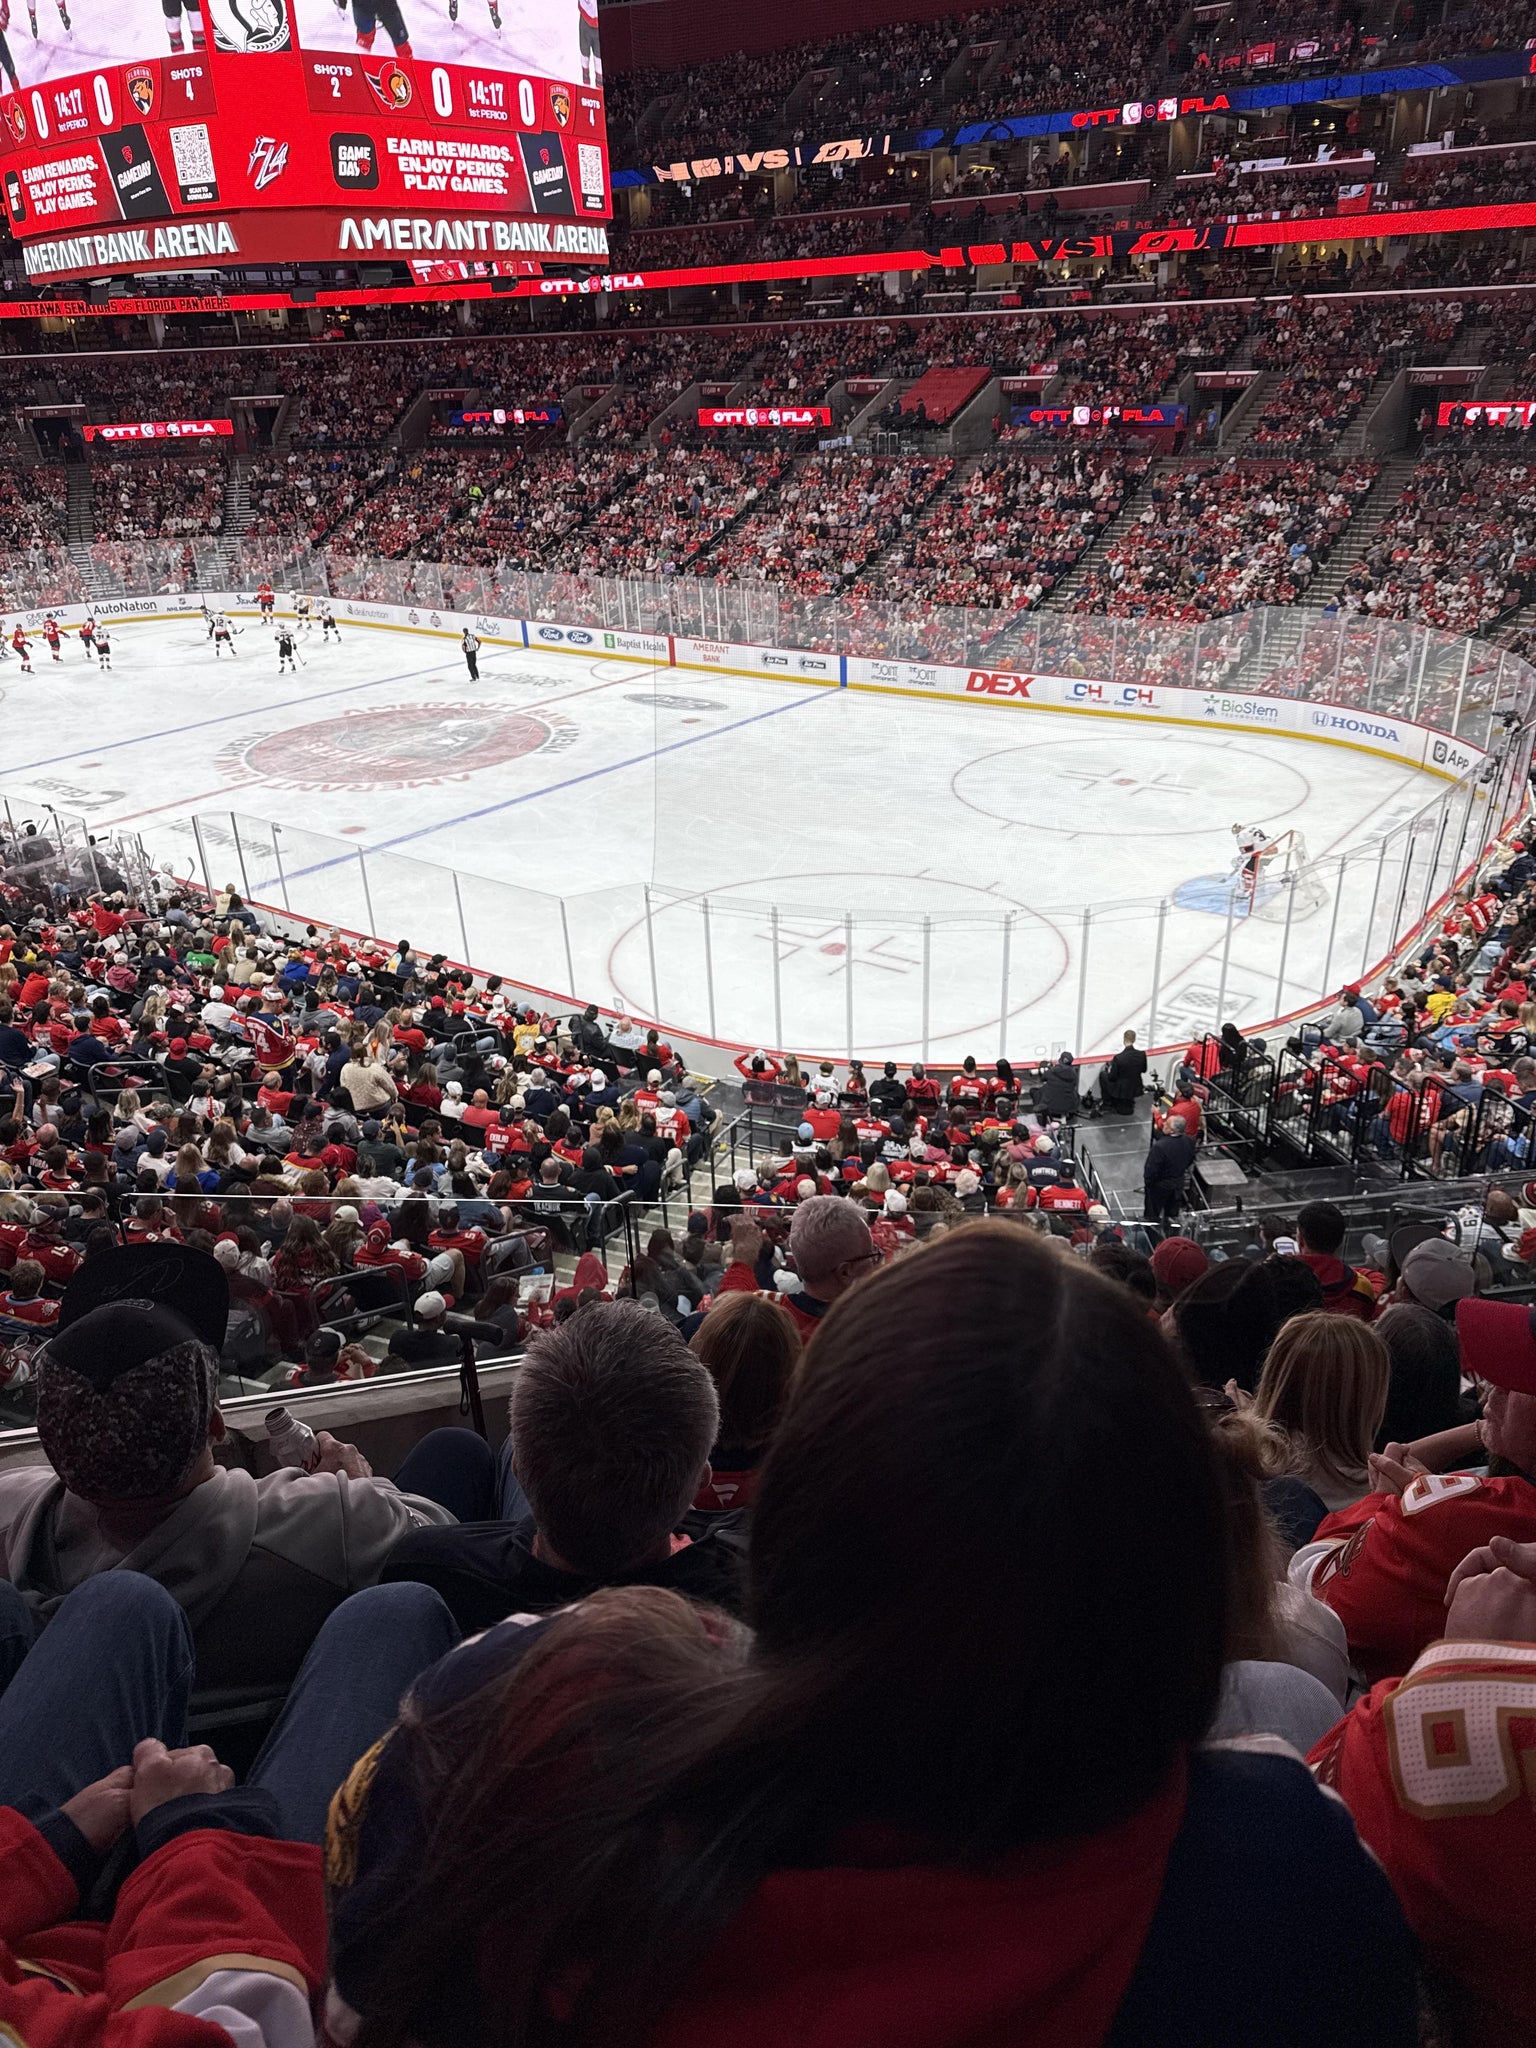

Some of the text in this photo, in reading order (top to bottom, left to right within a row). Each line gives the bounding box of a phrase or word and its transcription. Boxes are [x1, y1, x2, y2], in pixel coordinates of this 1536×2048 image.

[170, 67, 203, 80] SHOTS
[313, 63, 353, 77] SHOTS
[185, 80, 194, 101] 4
[330, 77, 341, 98] 2
[431, 67, 453, 117] 0
[469, 79, 505, 108] 14:17
[54, 88, 83, 118] 14:17
[93, 75, 113, 126] 0
[518, 79, 535, 126] 0
[31, 91, 49, 139] 0
[480, 109, 508, 121] PERIOD
[1071, 108, 1121, 128] OTT
[1181, 94, 1231, 114] FLA
[66, 118, 88, 131] PERIOD
[338, 145, 372, 161] GAME
[386, 137, 514, 162] EARN REWARDS.
[338, 161, 361, 177] DAY
[397, 156, 509, 178] ENJOY PERKS.
[737, 149, 789, 173] VS
[22, 155, 99, 184] EARN REWARDS.
[29, 180, 58, 200] ENJOY
[58, 173, 96, 193] PERKS.
[404, 174, 508, 195] PLAY GAMES.
[34, 197, 57, 216] PLAY
[57, 191, 97, 211] GAMES.
[339, 218, 609, 255] AMERANT BANK ARENA
[23, 222, 238, 275] AMERANT BANK ARENA
[614, 275, 644, 288] FLA
[19, 304, 61, 315] OTTAWA
[135, 300, 176, 313] FLORIDA
[180, 297, 230, 311] PANTHERS
[462, 412, 549, 422] OTT FLA
[713, 411, 814, 423] OTT FLA
[1029, 410, 1072, 422] OTT
[1122, 409, 1164, 422] FLA
[102, 423, 215, 438] OTT FLA
[94, 600, 157, 615] AutoNation
[216, 618, 224, 627] 12
[542, 628, 561, 641] Ford
[571, 631, 590, 644] Ford
[617, 637, 667, 653] Baptist Health
[692, 643, 730, 655] AMERANT
[703, 654, 721, 663] BANK
[878, 665, 898, 676] JOINT
[915, 669, 937, 681] JOINT
[966, 671, 1036, 698] DEX
[1073, 683, 1103, 698] CH
[1123, 688, 1153, 703] CH
[1221, 699, 1278, 717] BioStem
[343, 702, 580, 754] AMERANT BANK ARENA
[1330, 716, 1400, 742] HONDA
[1031, 1167, 1058, 1177] PANTHERS
[1053, 1199, 1081, 1209] BENNETT
[51, 1244, 69, 1258] 15
